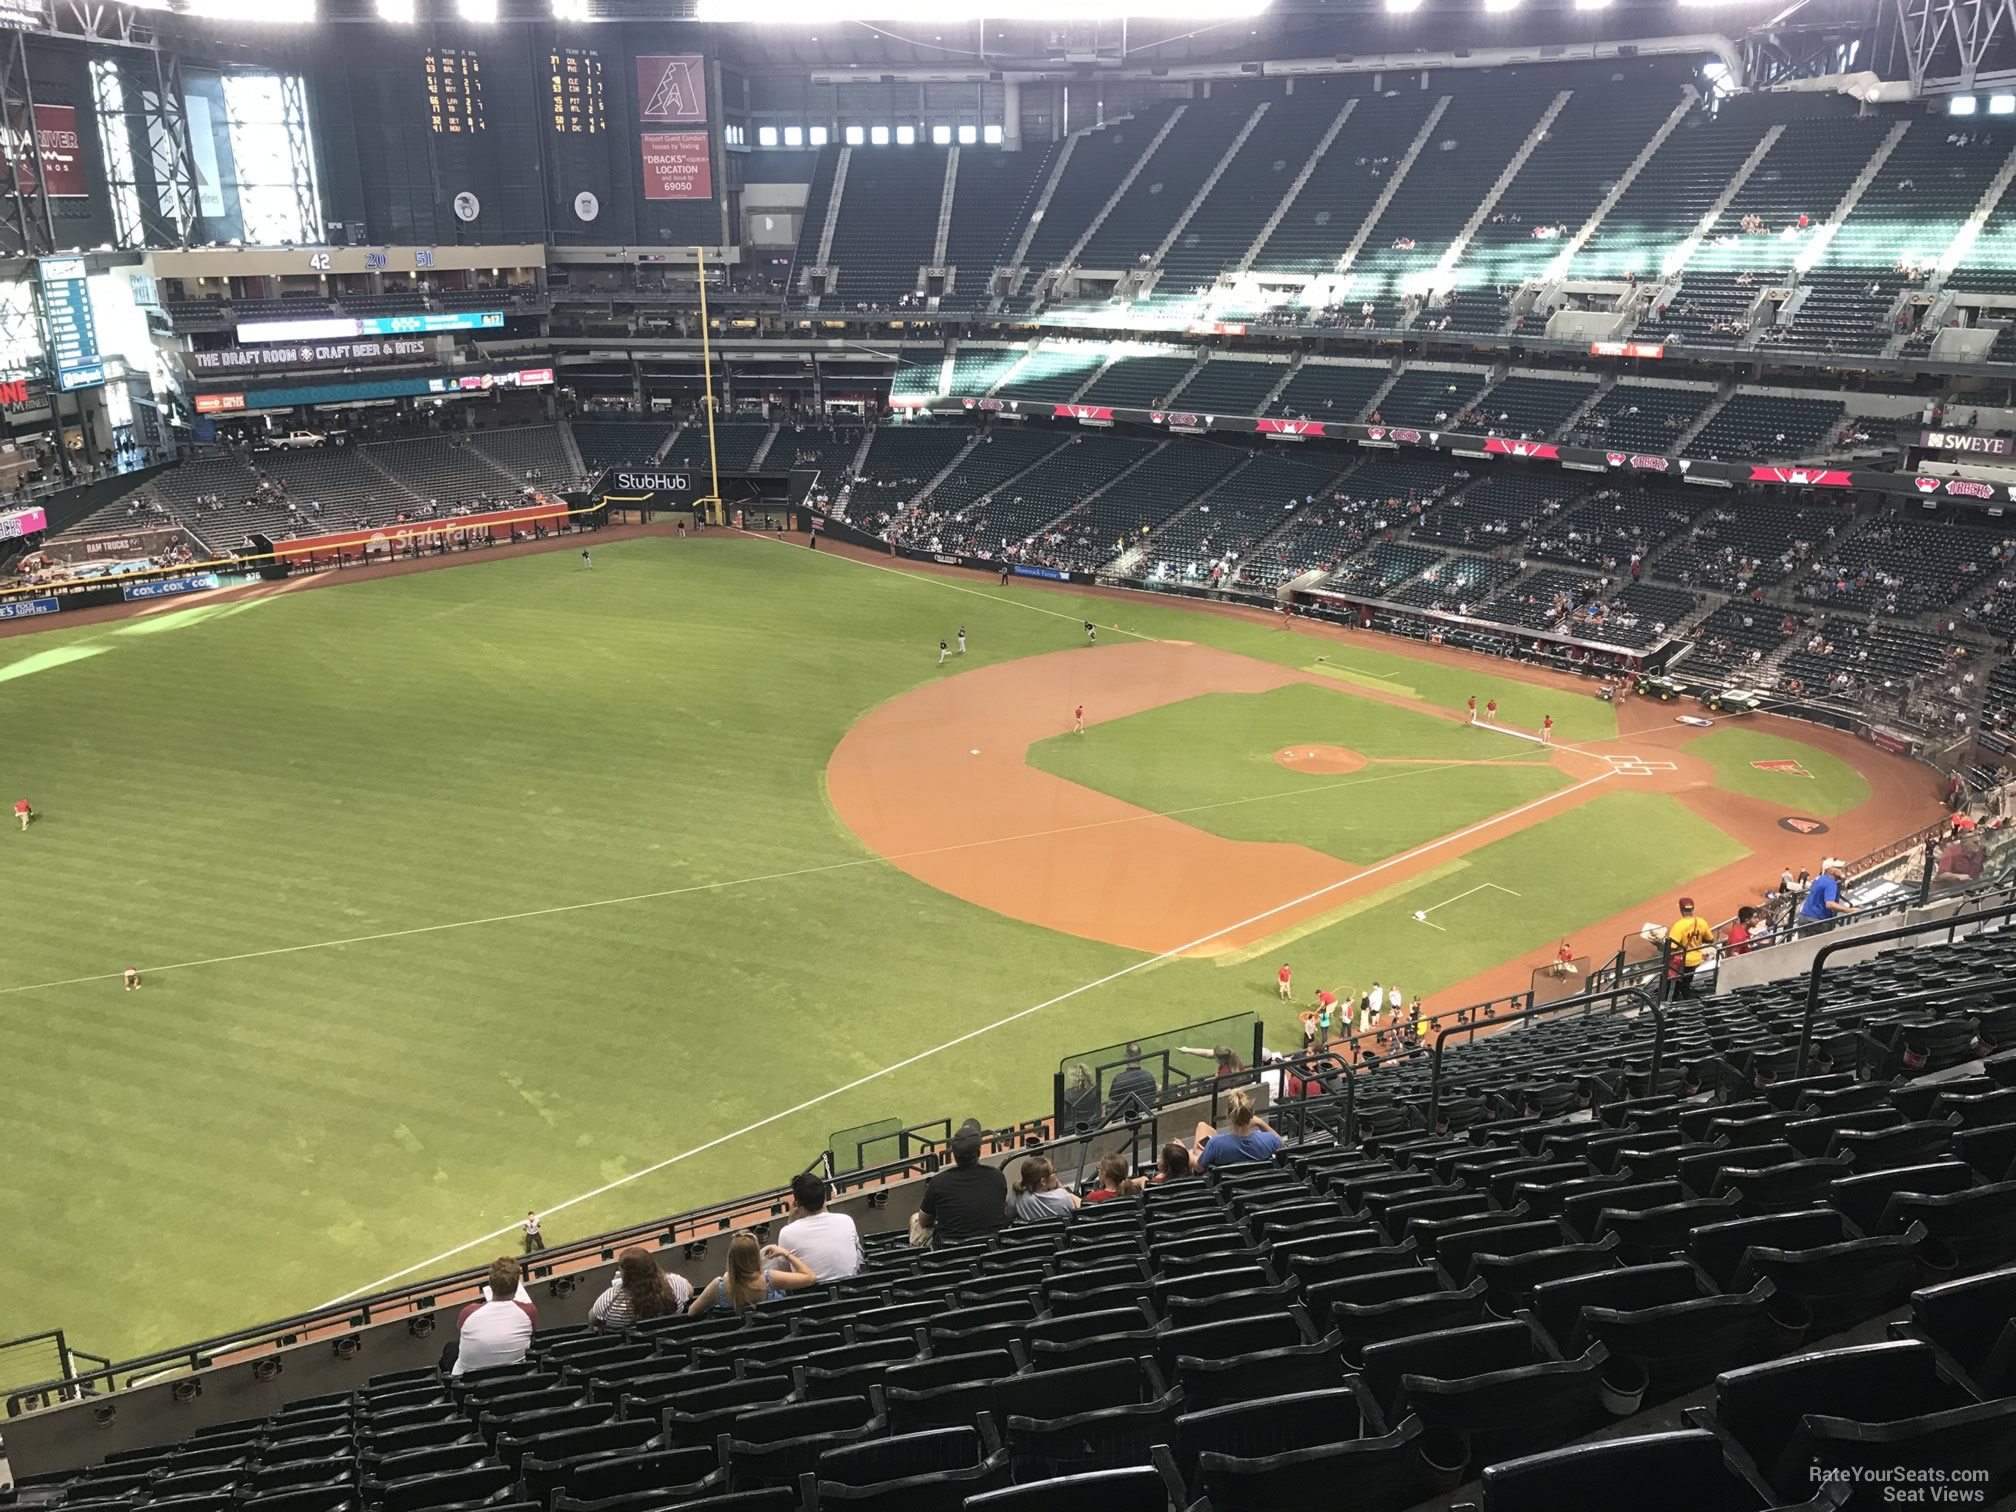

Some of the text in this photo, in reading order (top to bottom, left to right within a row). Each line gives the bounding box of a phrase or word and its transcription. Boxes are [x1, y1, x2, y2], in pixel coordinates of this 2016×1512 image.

[656, 165, 698, 174] LOCATION
[664, 182, 692, 191] 69050
[310, 254, 330, 270] 42
[366, 252, 387, 269] 20
[416, 251, 434, 267] 51
[195, 341, 424, 367] THE DRAFT ROOM CRAFT BEER & BITES
[25, 398, 49, 410] FITNESS
[1945, 435, 2004, 453] SWEYE
[618, 474, 686, 489] StubHub
[86, 544, 101, 553] RAM
[103, 540, 130, 550] TRUCKS
[133, 585, 155, 596] COX
[163, 582, 185, 593] COX
